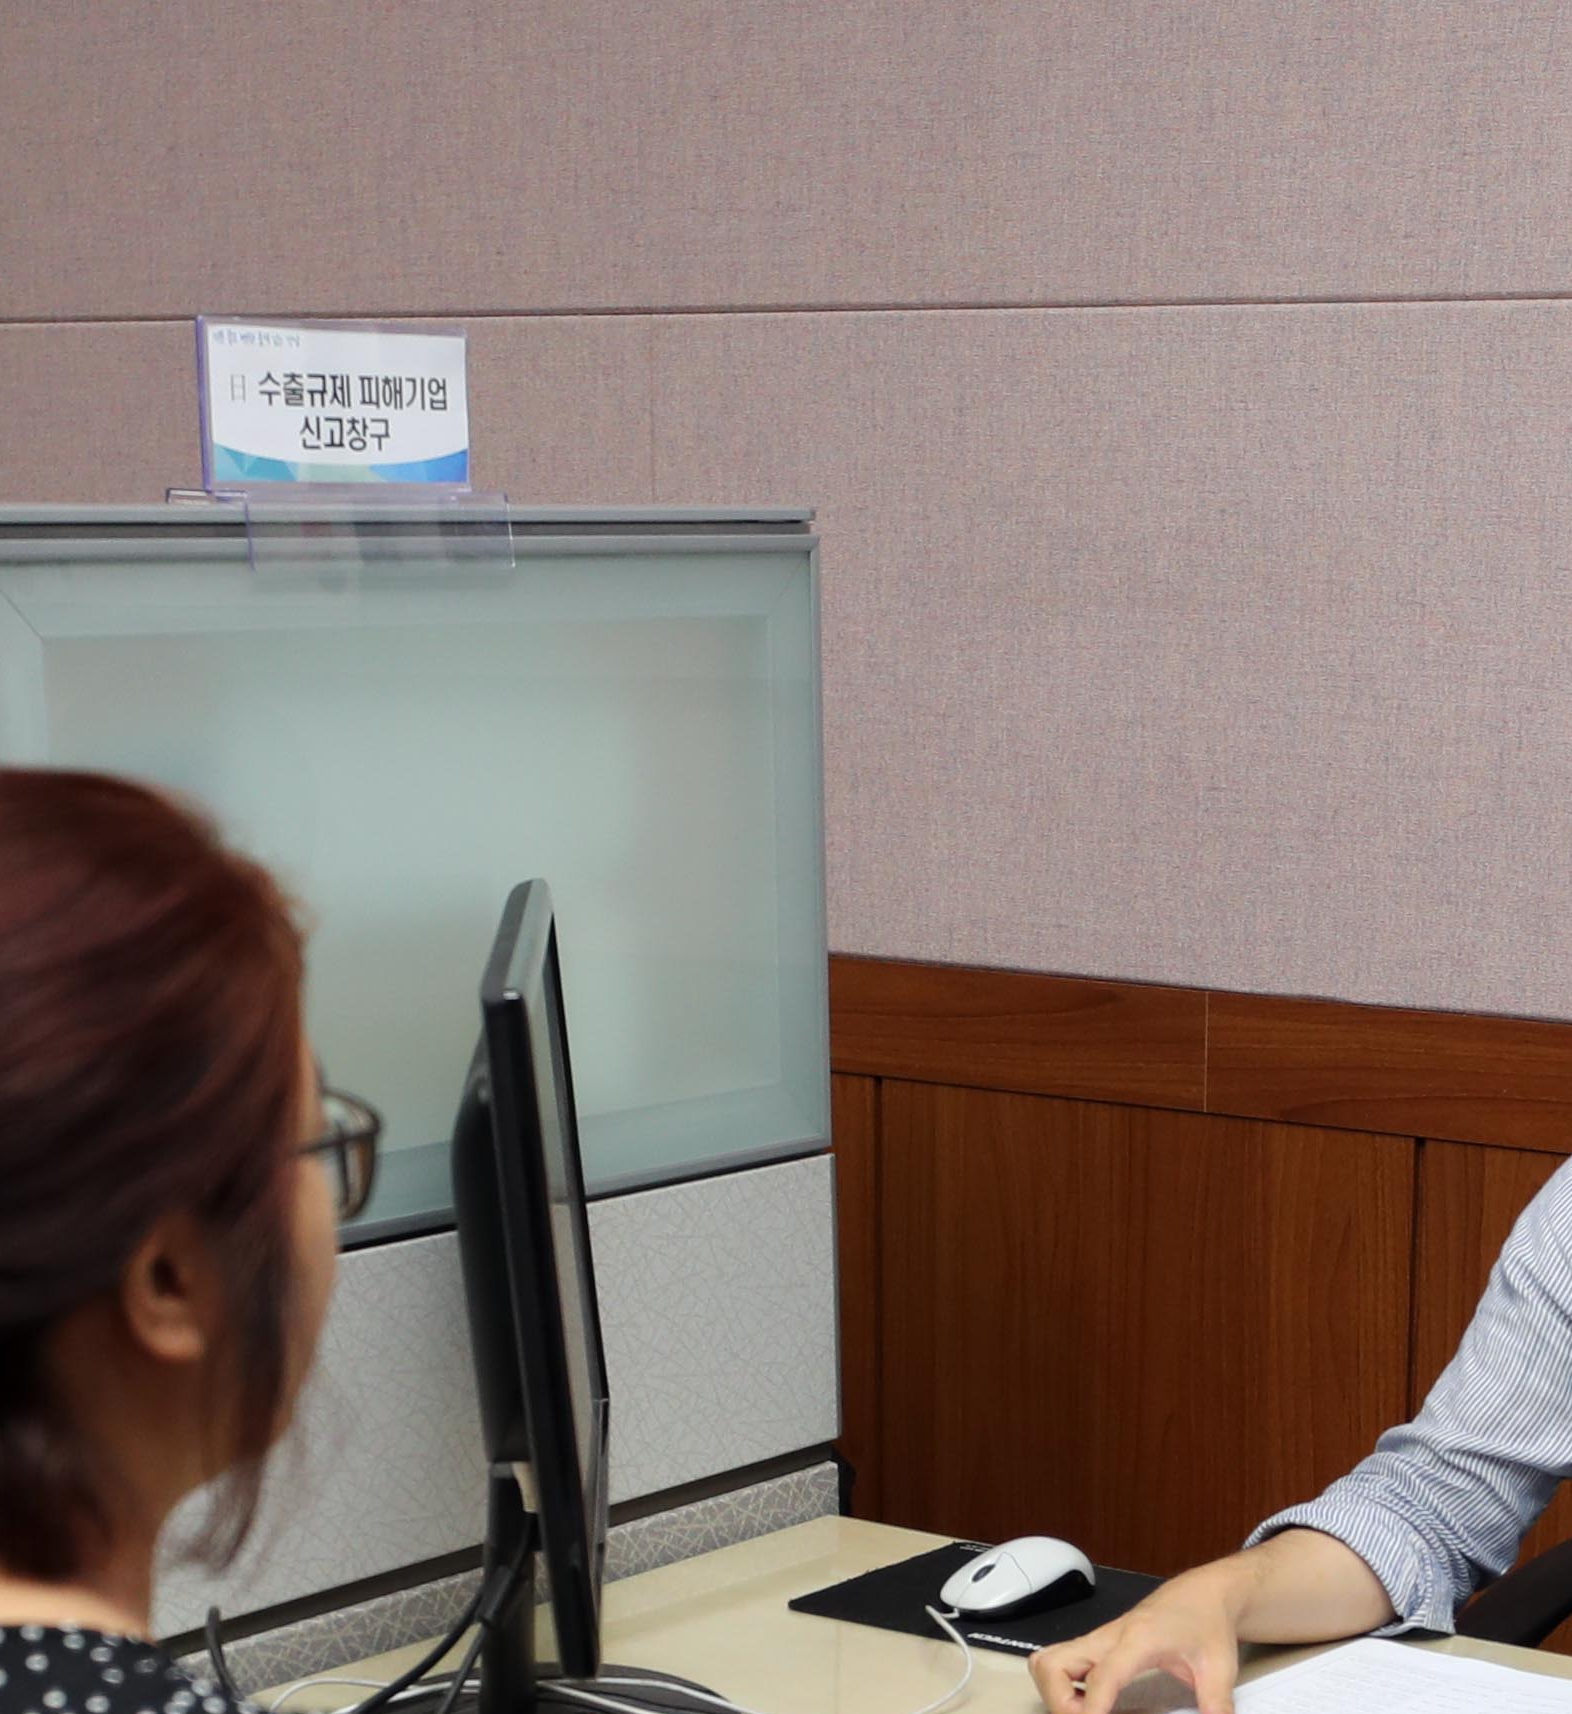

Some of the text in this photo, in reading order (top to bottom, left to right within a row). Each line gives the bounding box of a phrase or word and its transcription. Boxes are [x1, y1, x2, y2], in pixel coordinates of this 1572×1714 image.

[257, 370, 353, 410] 수출규제
[358, 373, 449, 412] 피해기업
[299, 415, 392, 453] 신고창구
